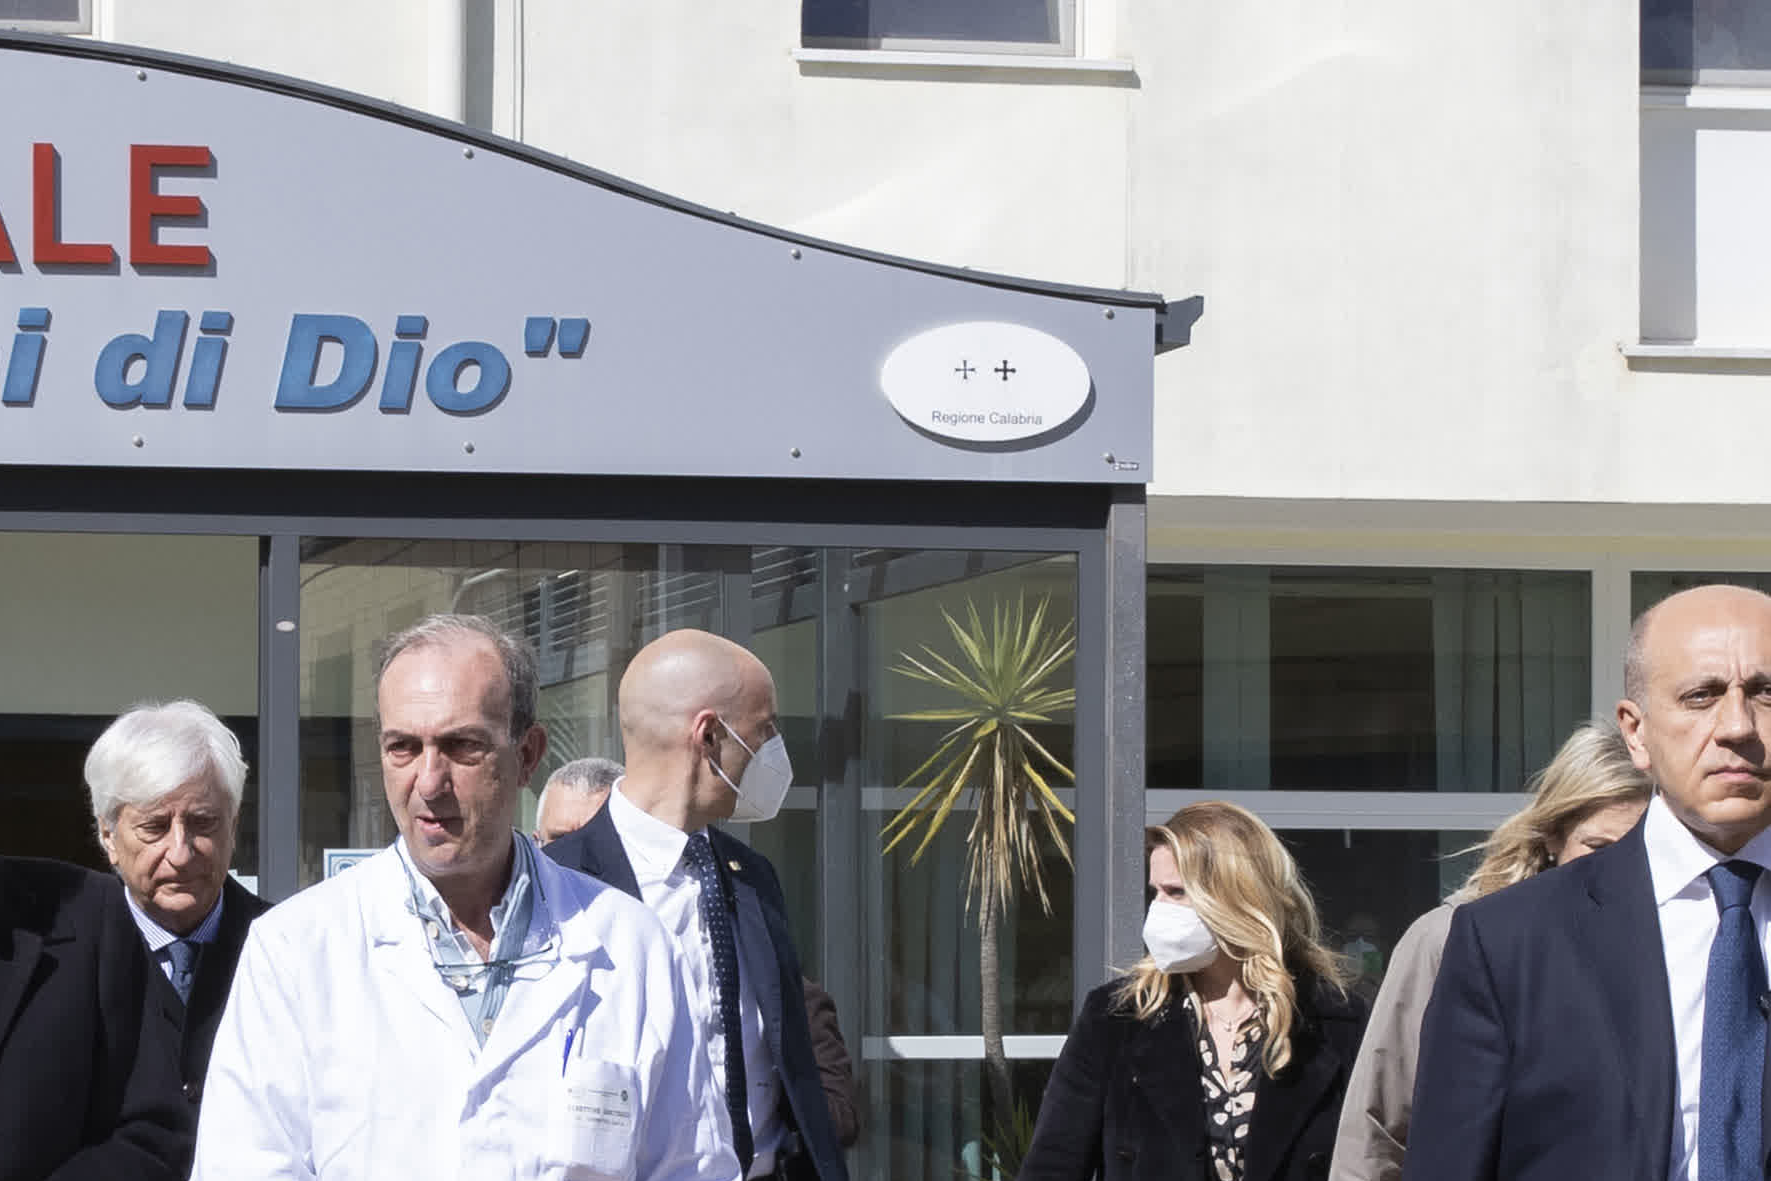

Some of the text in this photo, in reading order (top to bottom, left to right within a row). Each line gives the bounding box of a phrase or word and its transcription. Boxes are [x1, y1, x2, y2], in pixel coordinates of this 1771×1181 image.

[94, 309, 233, 408] di
[274, 312, 589, 413] Dio"
[931, 410, 1043, 426] Regione Calabria
